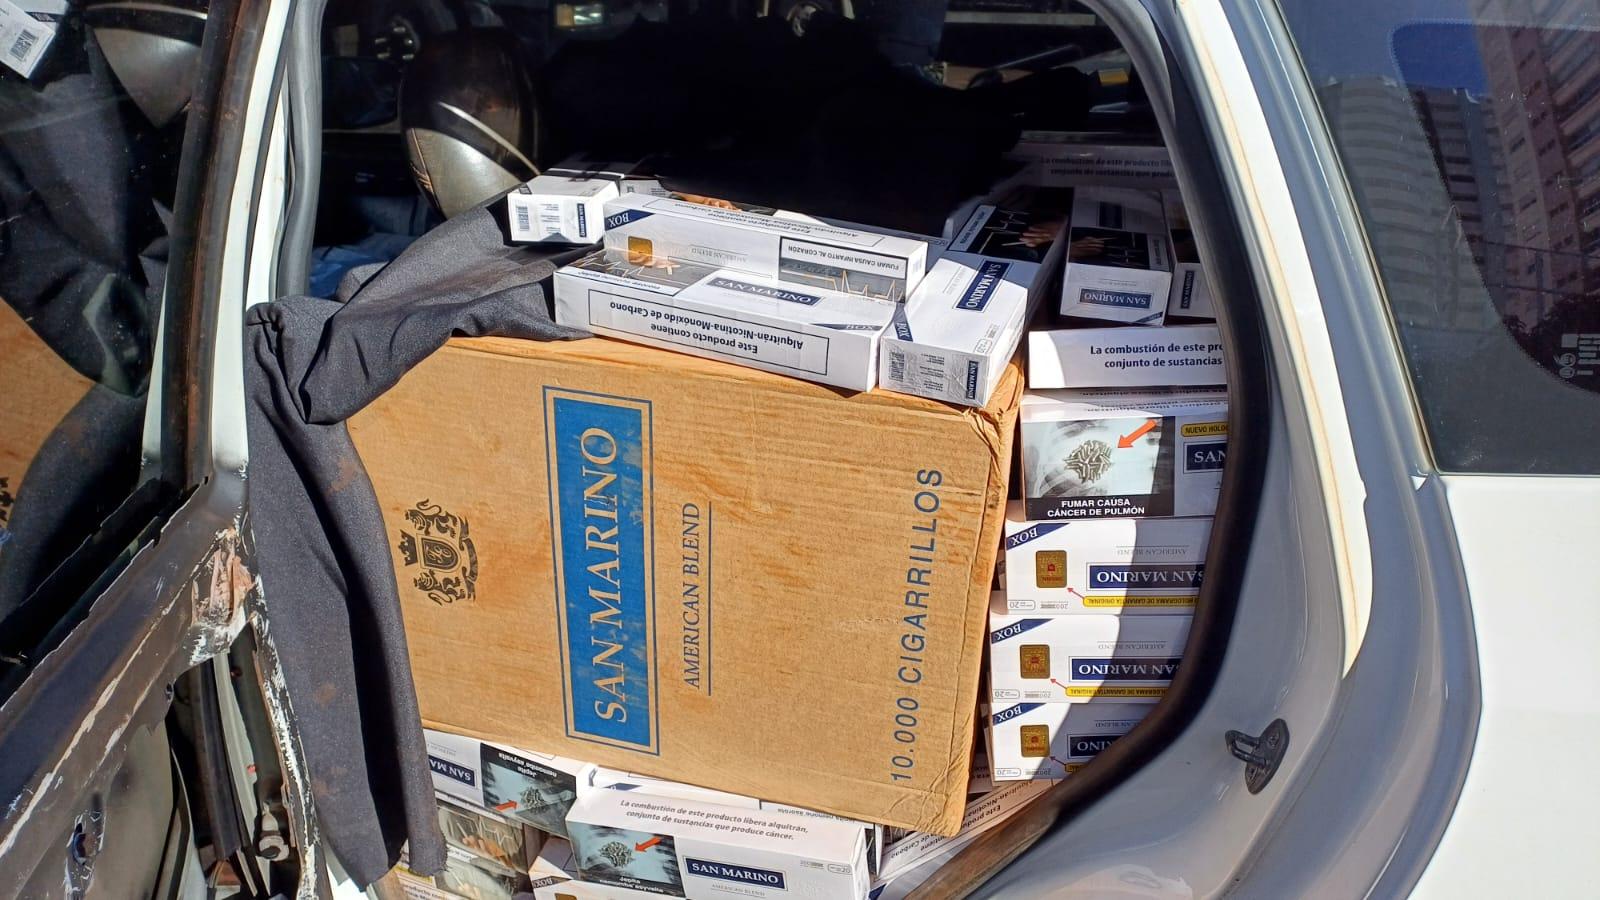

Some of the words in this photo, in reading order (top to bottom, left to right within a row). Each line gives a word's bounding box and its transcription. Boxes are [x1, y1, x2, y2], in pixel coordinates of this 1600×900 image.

[609, 212, 630, 227] BOX
[1084, 292, 1124, 304] MARINO
[1126, 296, 1146, 305] SAN
[610, 301, 648, 317] Carbono
[650, 310, 662, 319] de
[650, 322, 691, 339] contiene
[664, 313, 804, 350] Alquitrán-Nicotina-Monóxido
[692, 332, 736, 349] producto
[738, 342, 758, 354] Este
[1090, 346, 1102, 355] La
[1104, 344, 1164, 355] combustión
[1168, 344, 1180, 352] de
[1183, 344, 1205, 352] este
[1104, 358, 1150, 370] conjunto
[1152, 358, 1166, 366] de
[1168, 356, 1222, 366] sustancias
[1185, 425, 1208, 434] NUEVO
[1062, 500, 1094, 508] FUMAR
[1097, 498, 1130, 507] CAUSA
[1047, 508, 1086, 517] CÁNCER
[1104, 506, 1144, 515] PULMÓN
[580, 426, 624, 632] MARINO
[1011, 527, 1038, 546] BOX
[682, 502, 700, 577] BLEND
[899, 468, 943, 684] CIGARRILLOS
[1096, 571, 1166, 583] MARINO
[677, 578, 701, 690] AMERICAN
[996, 624, 1022, 642] BOX
[1078, 664, 1147, 675] MARINO
[1152, 664, 1179, 675] AN
[593, 641, 627, 725] SAN
[998, 706, 1022, 722] BOX
[890, 696, 920, 784] 10.000
[428, 759, 446, 772] MA
[448, 766, 470, 782] SAN
[620, 799, 629, 807] La
[630, 801, 676, 813] combustión
[677, 807, 687, 815] de
[688, 808, 705, 818] este
[705, 810, 742, 824] producto
[743, 816, 766, 826] libera
[986, 804, 1001, 816] Este
[626, 810, 660, 822] conjunto
[662, 814, 672, 823] de
[673, 817, 713, 828] sustancias
[714, 823, 729, 832] que
[730, 825, 764, 836] produce
[920, 836, 946, 852] ntiene
[692, 862, 719, 875] SAN
[721, 868, 779, 884] MARINO
